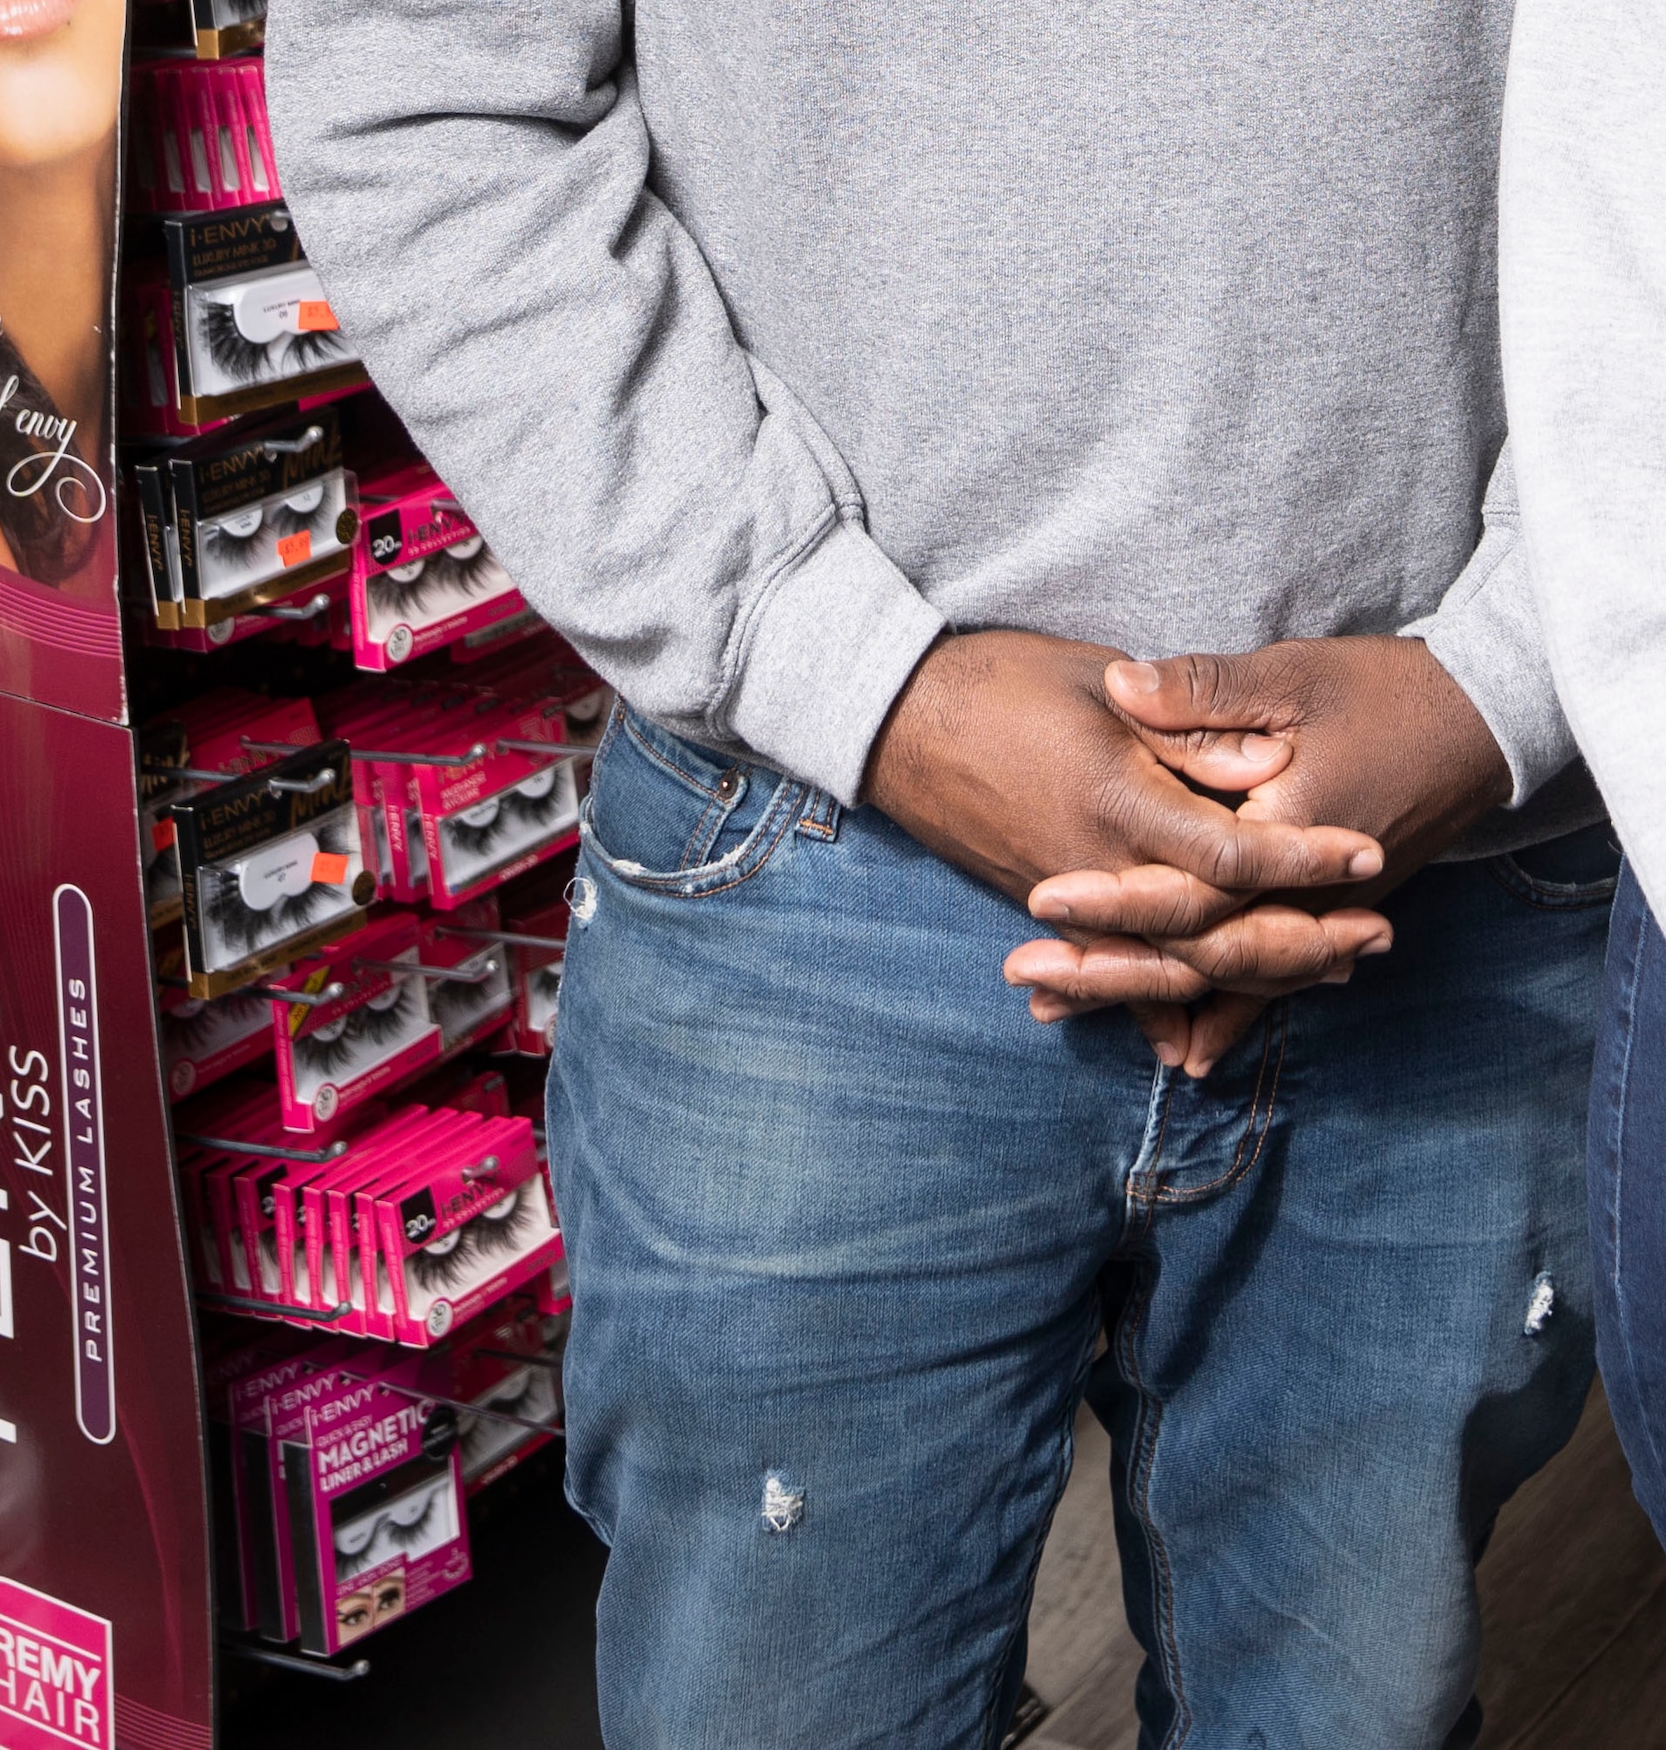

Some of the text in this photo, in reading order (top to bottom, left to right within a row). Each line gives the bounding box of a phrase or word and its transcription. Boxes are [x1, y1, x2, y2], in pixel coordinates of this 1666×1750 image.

[7, 408, 106, 523] envy
[9, 1044, 67, 1262] by KISS
[69, 978, 104, 1363] PREMIUM LASHES
[316, 1400, 433, 1474] MAGNETIC
